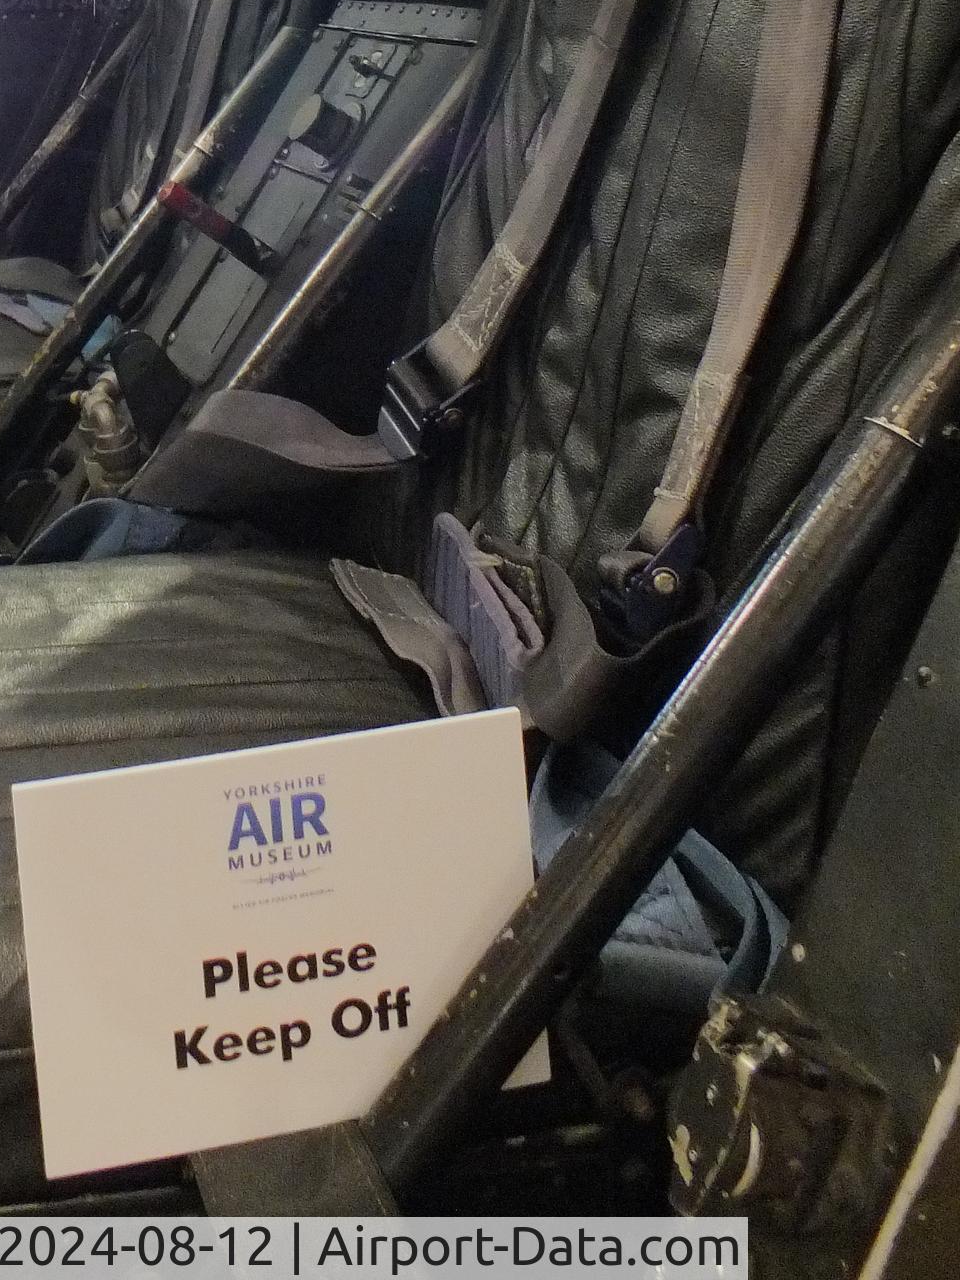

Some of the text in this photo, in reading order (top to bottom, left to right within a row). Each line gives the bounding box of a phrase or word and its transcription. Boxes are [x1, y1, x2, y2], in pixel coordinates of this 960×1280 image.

[224, 773, 327, 801] YORKSHIRE
[227, 791, 330, 851] AIR
[228, 840, 333, 871] MUSEUM
[202, 942, 378, 999] Please
[173, 985, 411, 1069] Keep Off
